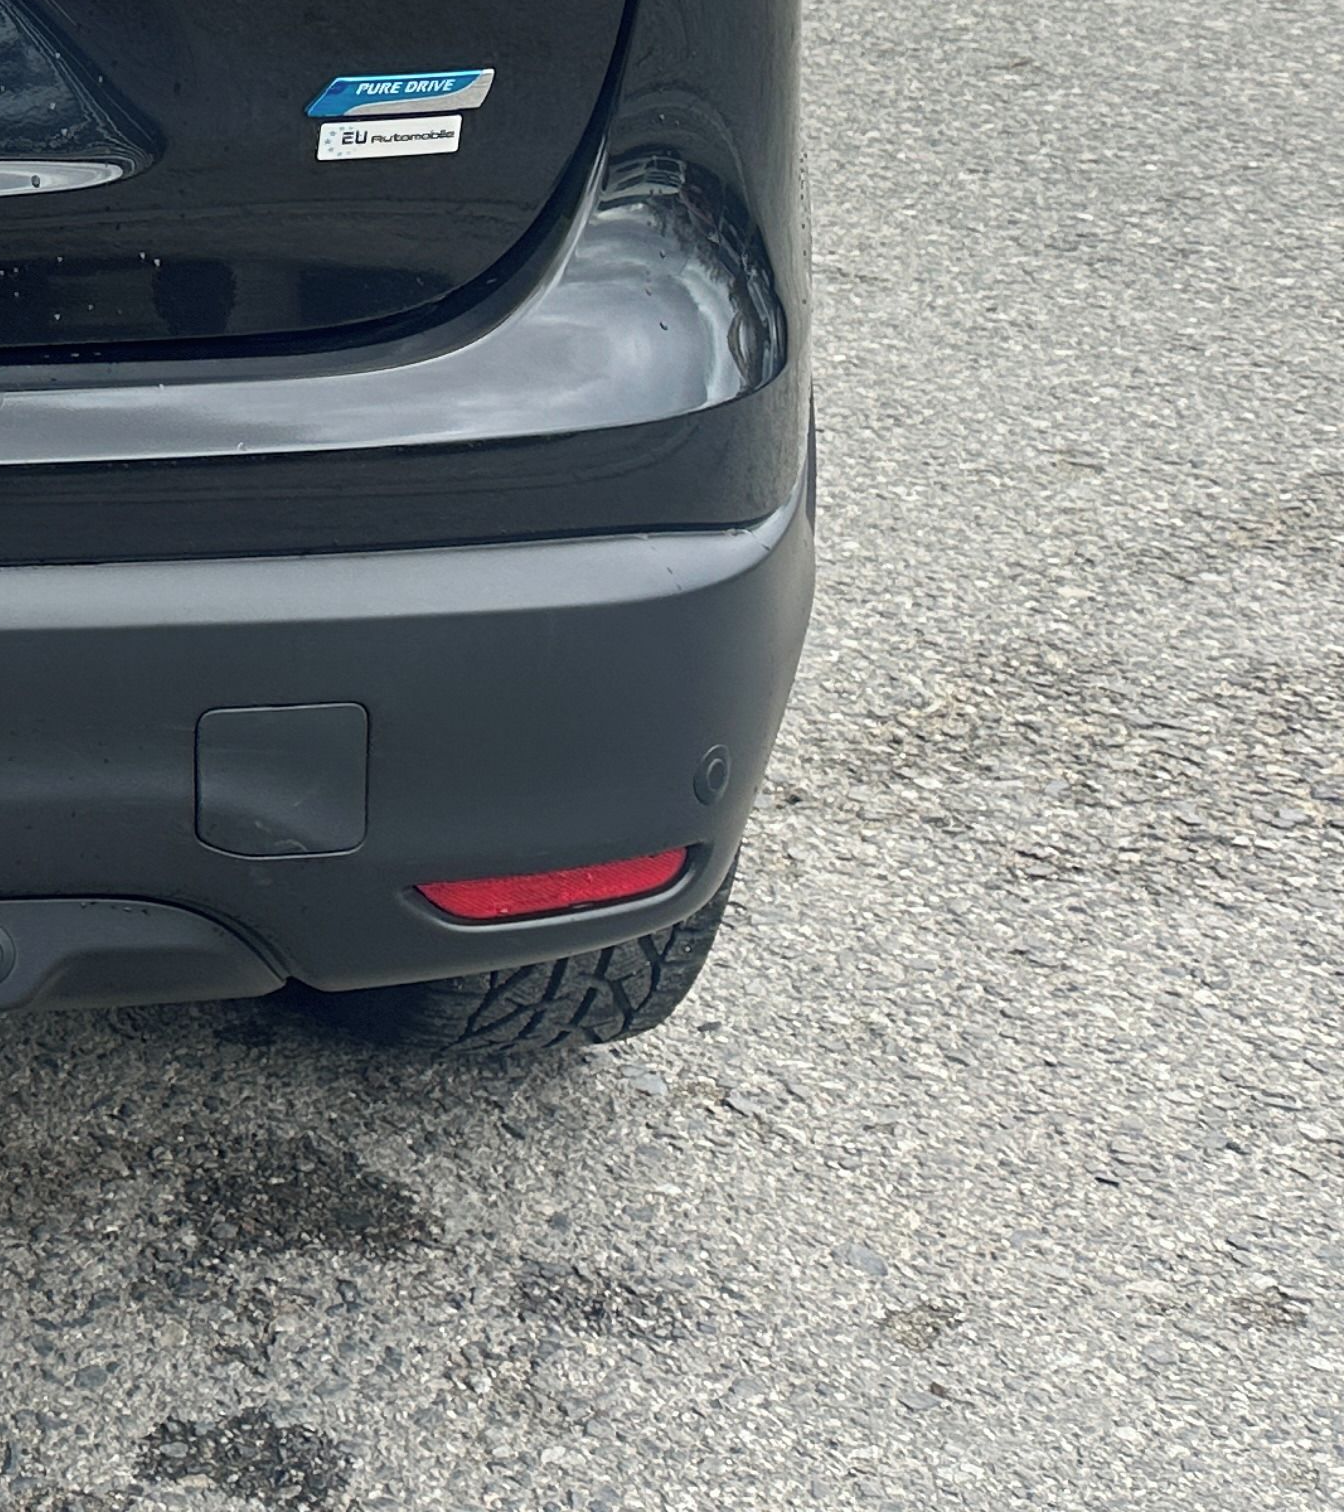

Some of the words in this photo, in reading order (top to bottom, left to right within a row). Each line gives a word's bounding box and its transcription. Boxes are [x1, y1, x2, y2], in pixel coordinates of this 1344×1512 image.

[356, 82, 402, 95] PURE
[404, 79, 456, 93] DRIVE
[341, 130, 369, 145] EU
